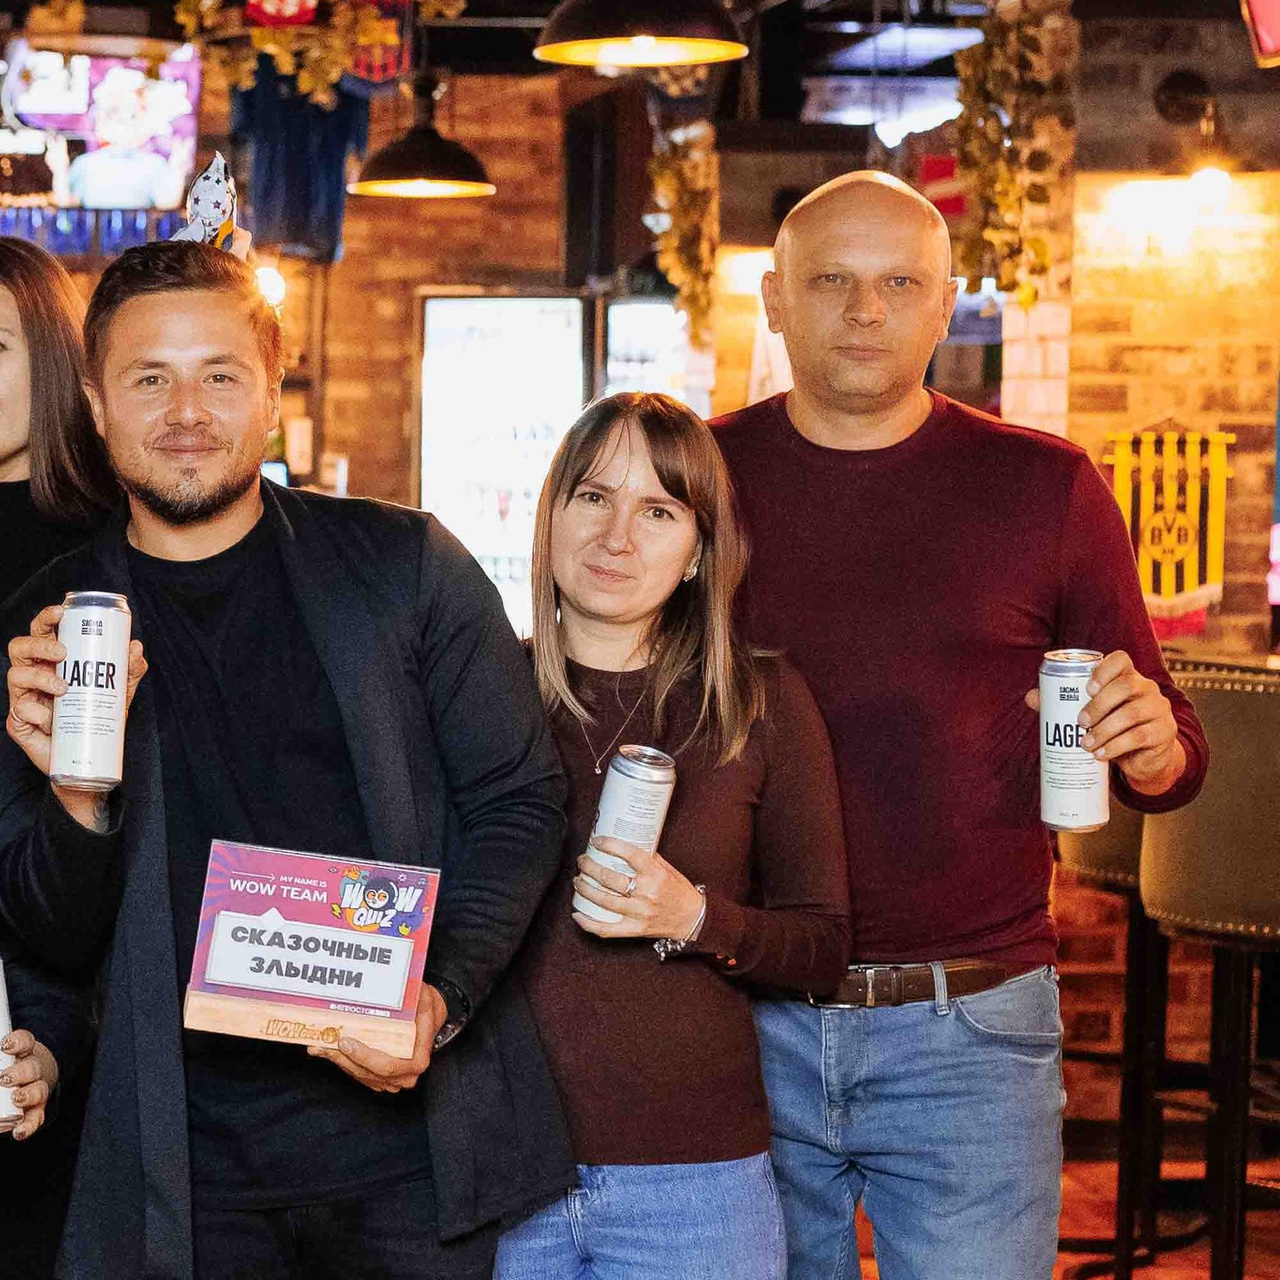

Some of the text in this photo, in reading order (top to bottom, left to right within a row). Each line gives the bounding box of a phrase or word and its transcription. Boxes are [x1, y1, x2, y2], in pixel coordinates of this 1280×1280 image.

[63, 660, 116, 690] LAGER
[1045, 721, 1089, 748] LAGE
[229, 878, 328, 903] WOW TEAM
[279, 875, 328, 888] MY NAME IS
[353, 907, 397, 928] QUIZ
[230, 926, 393, 965] СКАЗОЧНЫЕ
[249, 956, 364, 989] ЗЛЫДНИ
